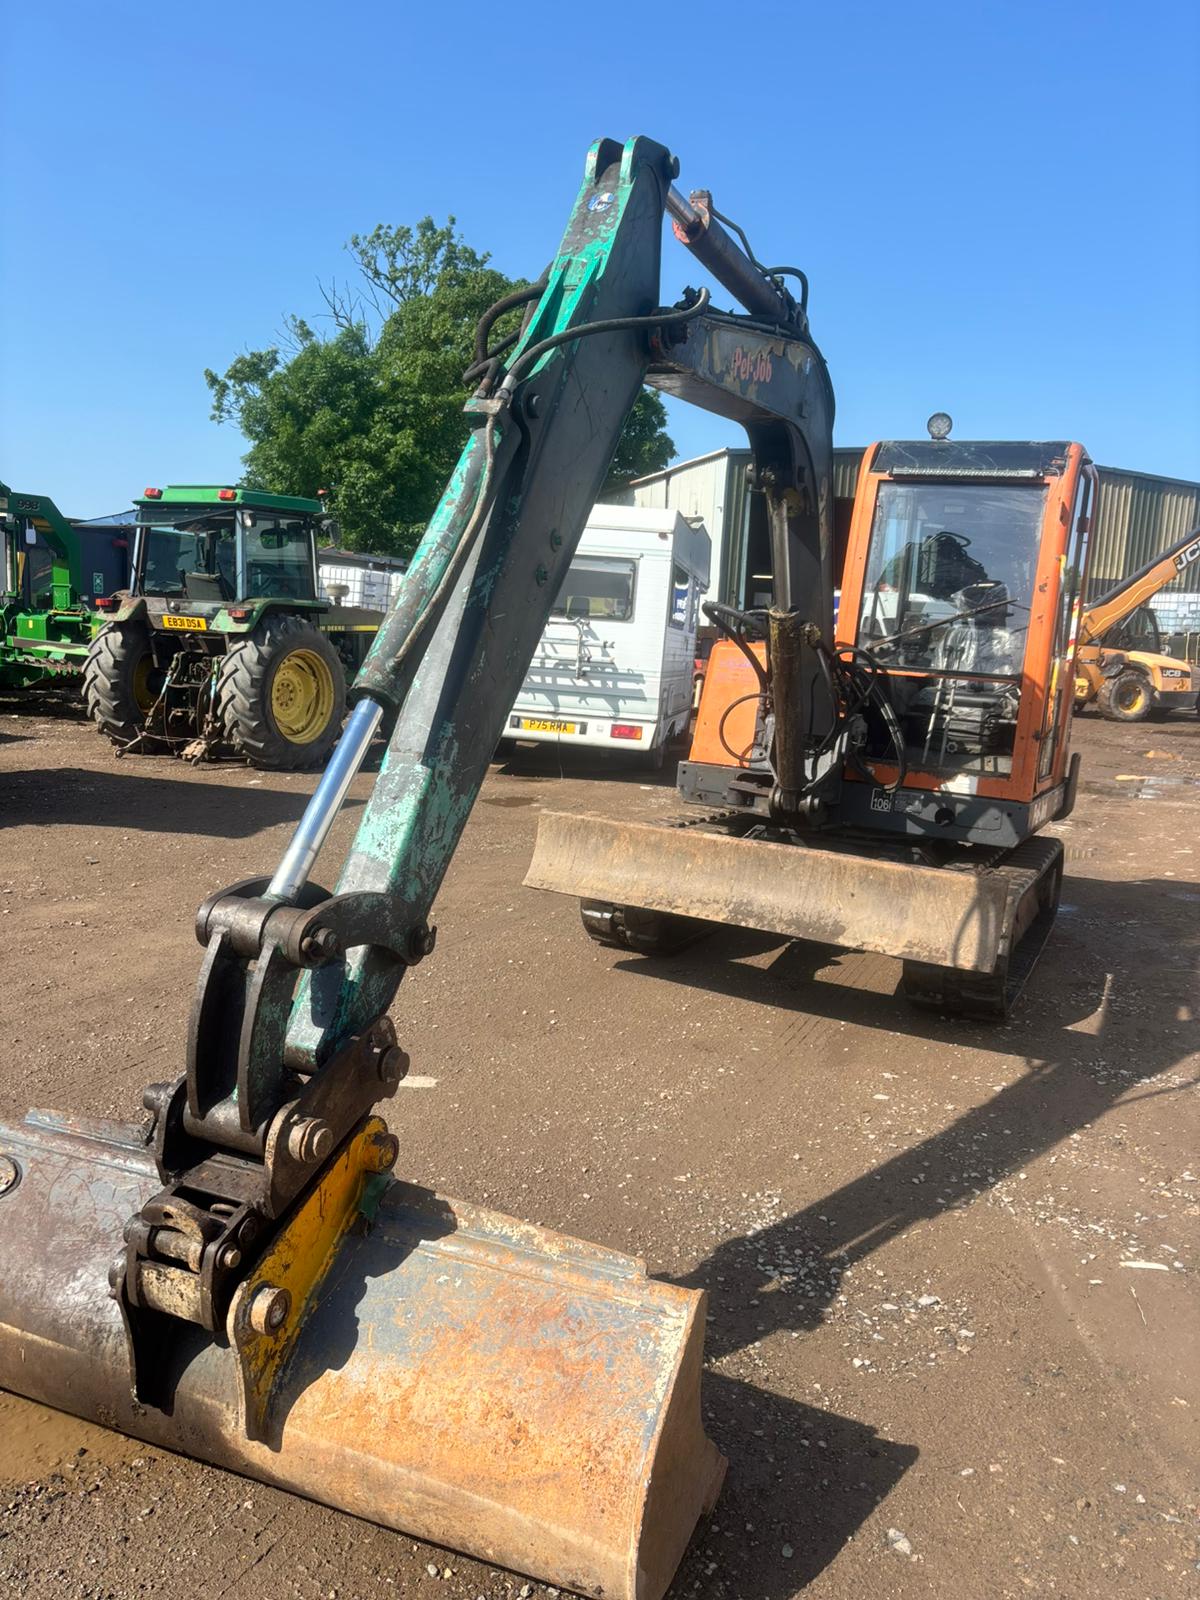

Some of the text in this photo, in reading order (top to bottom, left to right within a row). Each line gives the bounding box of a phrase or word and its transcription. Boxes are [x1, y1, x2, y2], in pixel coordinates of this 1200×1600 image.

[186, 619, 203, 629] DSA
[1163, 669, 1182, 678] JCB
[529, 719, 549, 730] P75
[873, 798, 890, 810] 106
